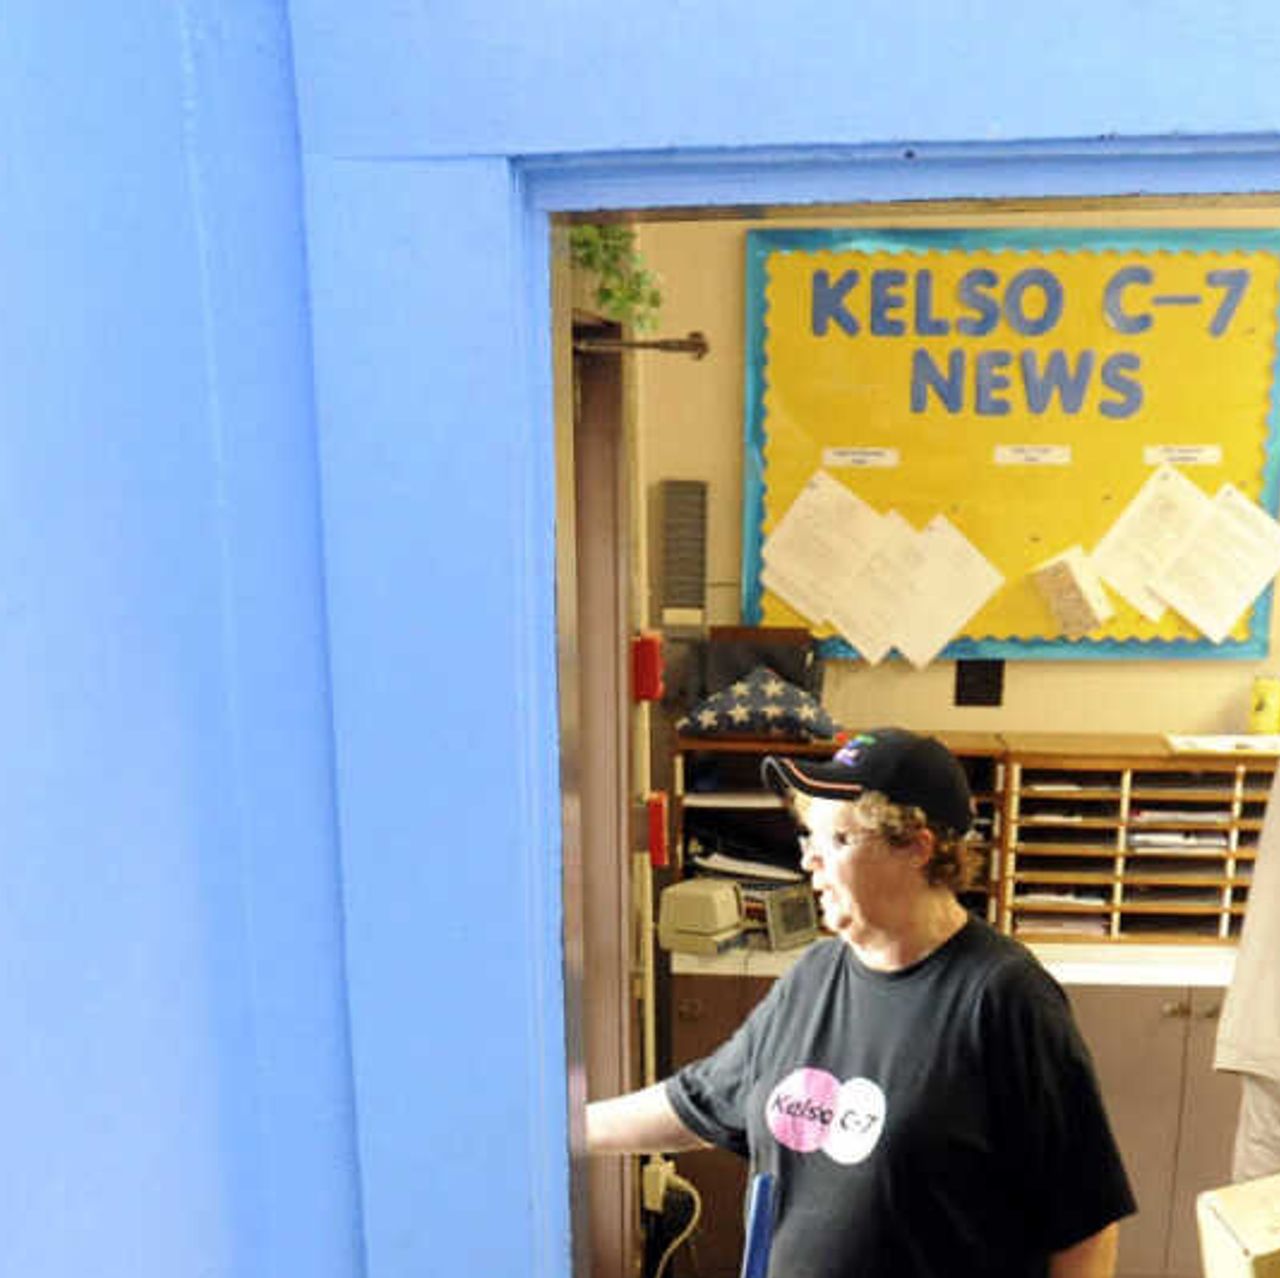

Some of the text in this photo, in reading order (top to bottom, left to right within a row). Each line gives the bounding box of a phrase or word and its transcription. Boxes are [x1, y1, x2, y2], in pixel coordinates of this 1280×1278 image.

[811, 265, 1251, 338] KELSO C-7
[909, 347, 1145, 418] NEWS
[773, 1095, 878, 1134] Kelso C-7
